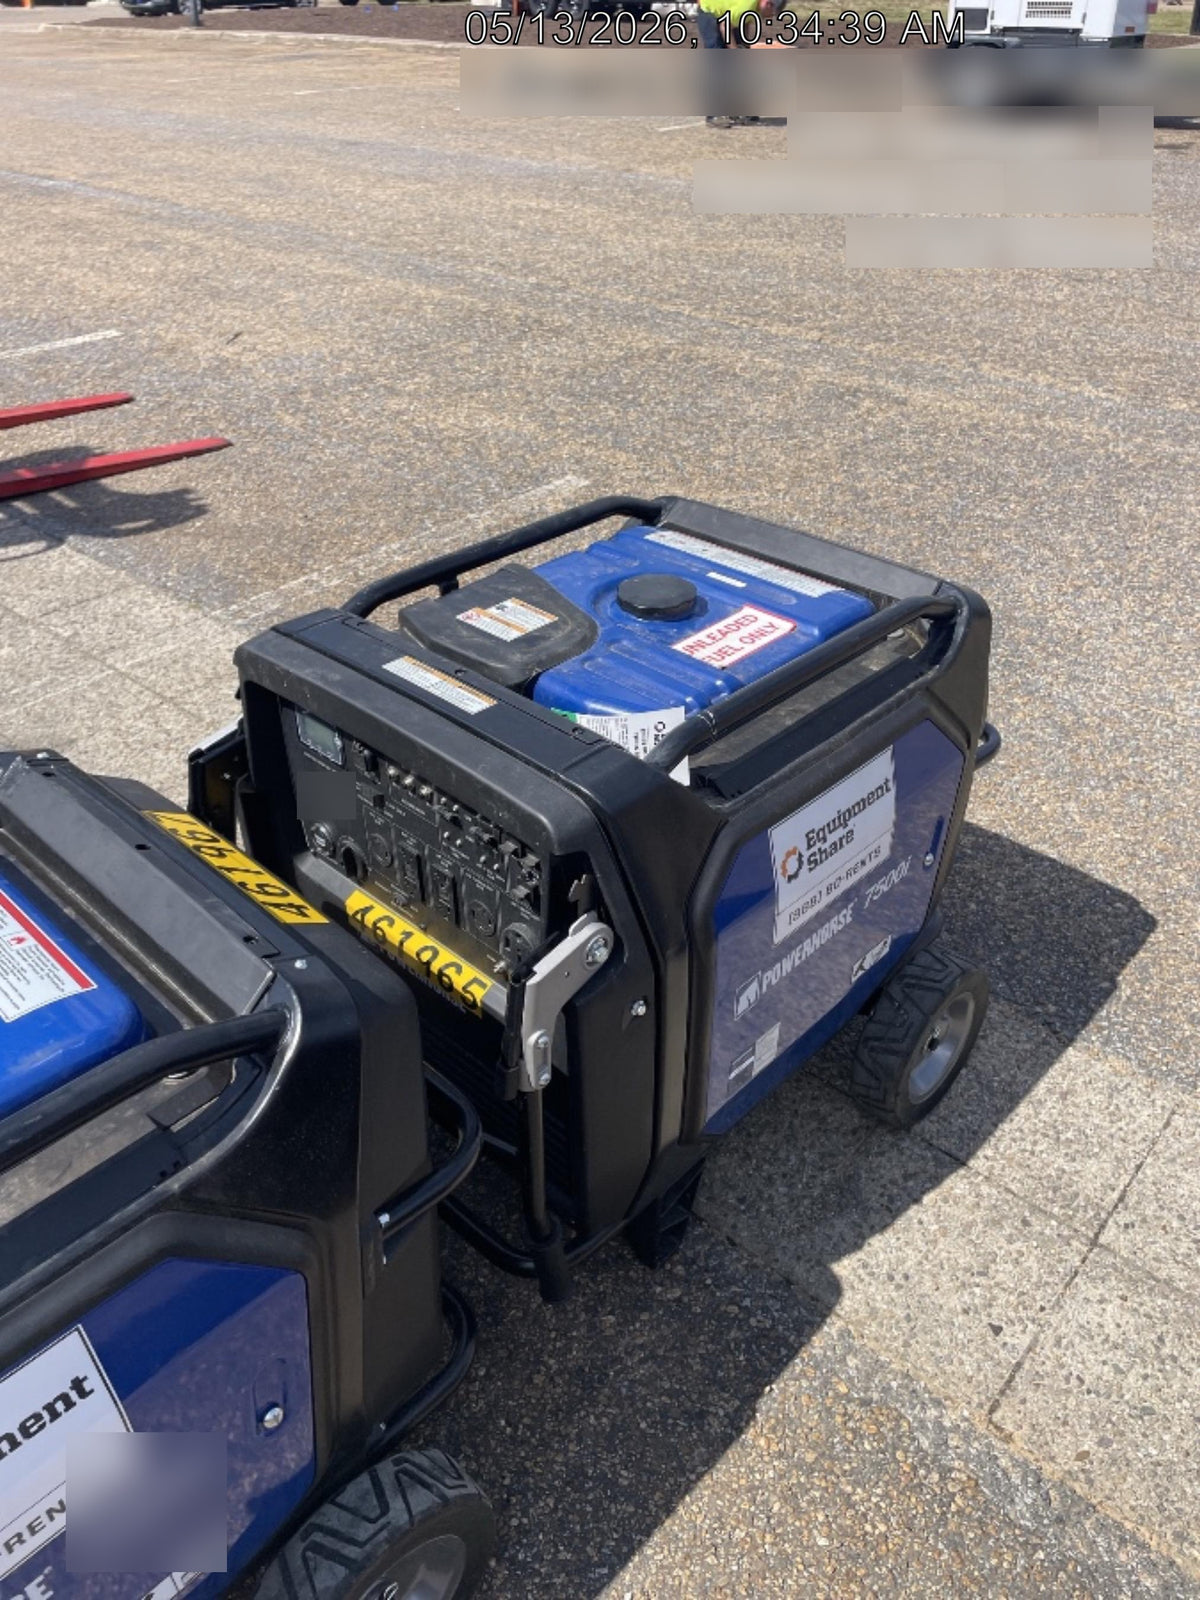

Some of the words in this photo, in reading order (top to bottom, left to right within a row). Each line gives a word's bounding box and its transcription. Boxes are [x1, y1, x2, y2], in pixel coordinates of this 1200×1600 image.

[701, 644, 744, 662] UEL
[739, 621, 779, 645] ONLY
[805, 778, 891, 851] Equipment
[806, 828, 855, 873] Share
[352, 905, 488, 1010] 461965
[762, 903, 854, 993] POWERHORSE
